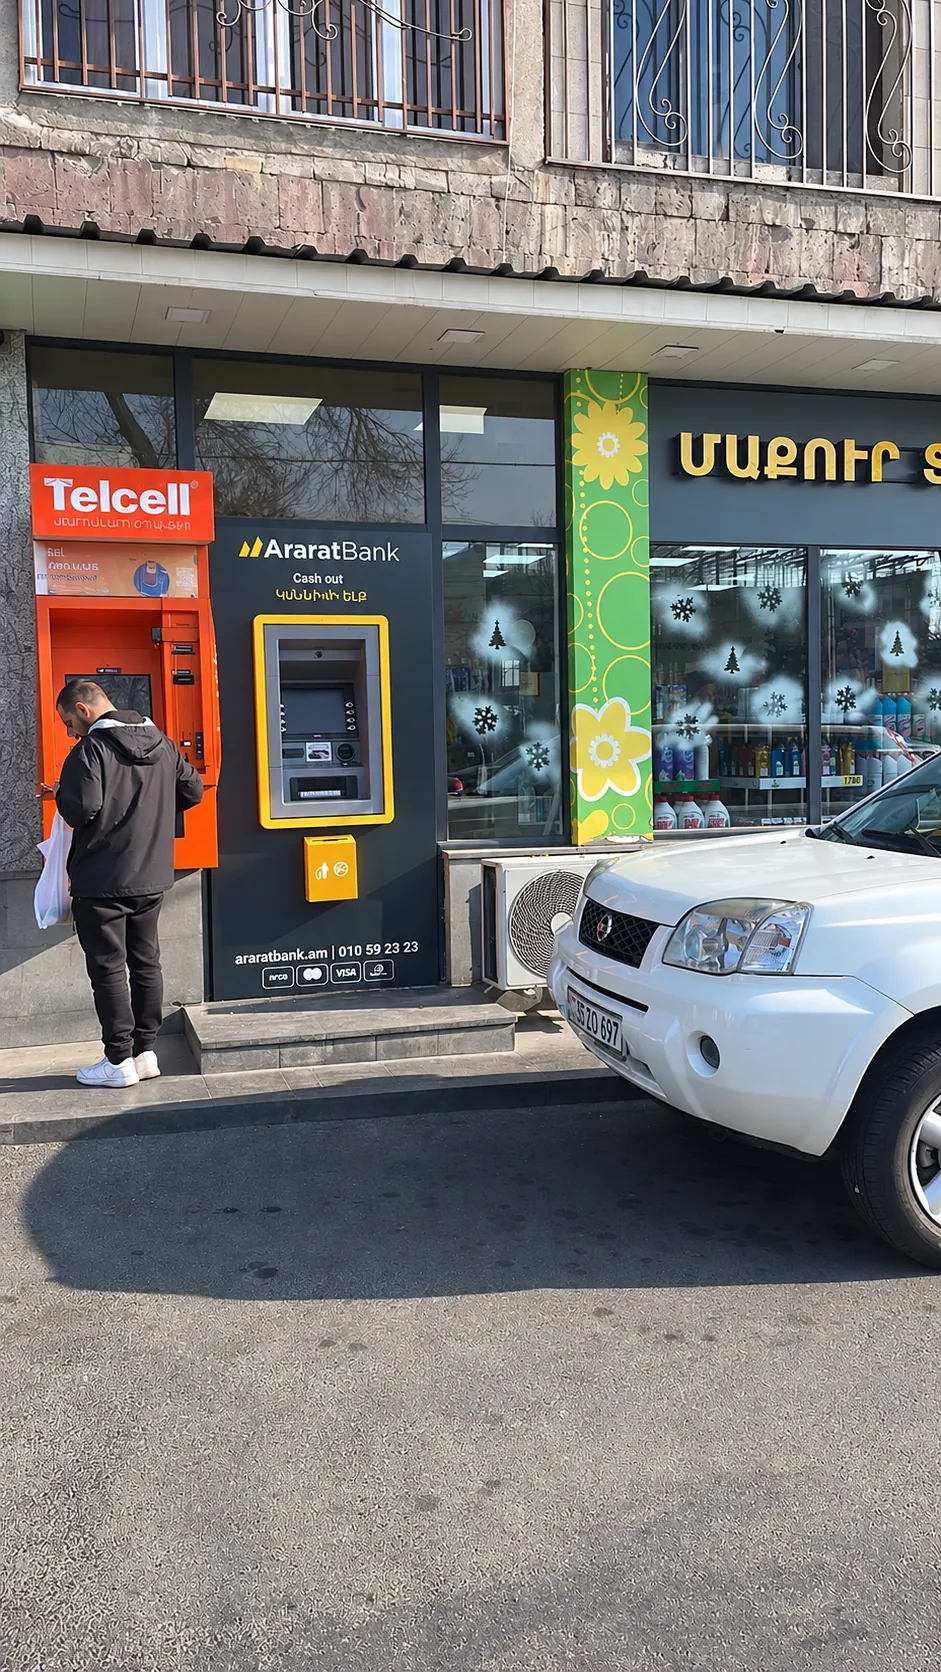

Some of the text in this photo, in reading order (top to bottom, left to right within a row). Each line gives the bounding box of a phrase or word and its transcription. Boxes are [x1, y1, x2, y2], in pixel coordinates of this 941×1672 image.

[680, 432, 900, 482] ՄԱՔՈՒՐ
[44, 478, 191, 516] Telcell
[264, 539, 400, 562] AraratBank
[293, 573, 344, 584] Cash out
[343, 589, 367, 603] ԵԼՔ
[235, 947, 328, 965] araratbank.am
[339, 945, 362, 958] 010
[366, 944, 381, 956] 59
[384, 942, 400, 954] 23
[403, 941, 419, 953] 23
[336, 967, 357, 978] VISA
[600, 1015, 619, 1046] 697
